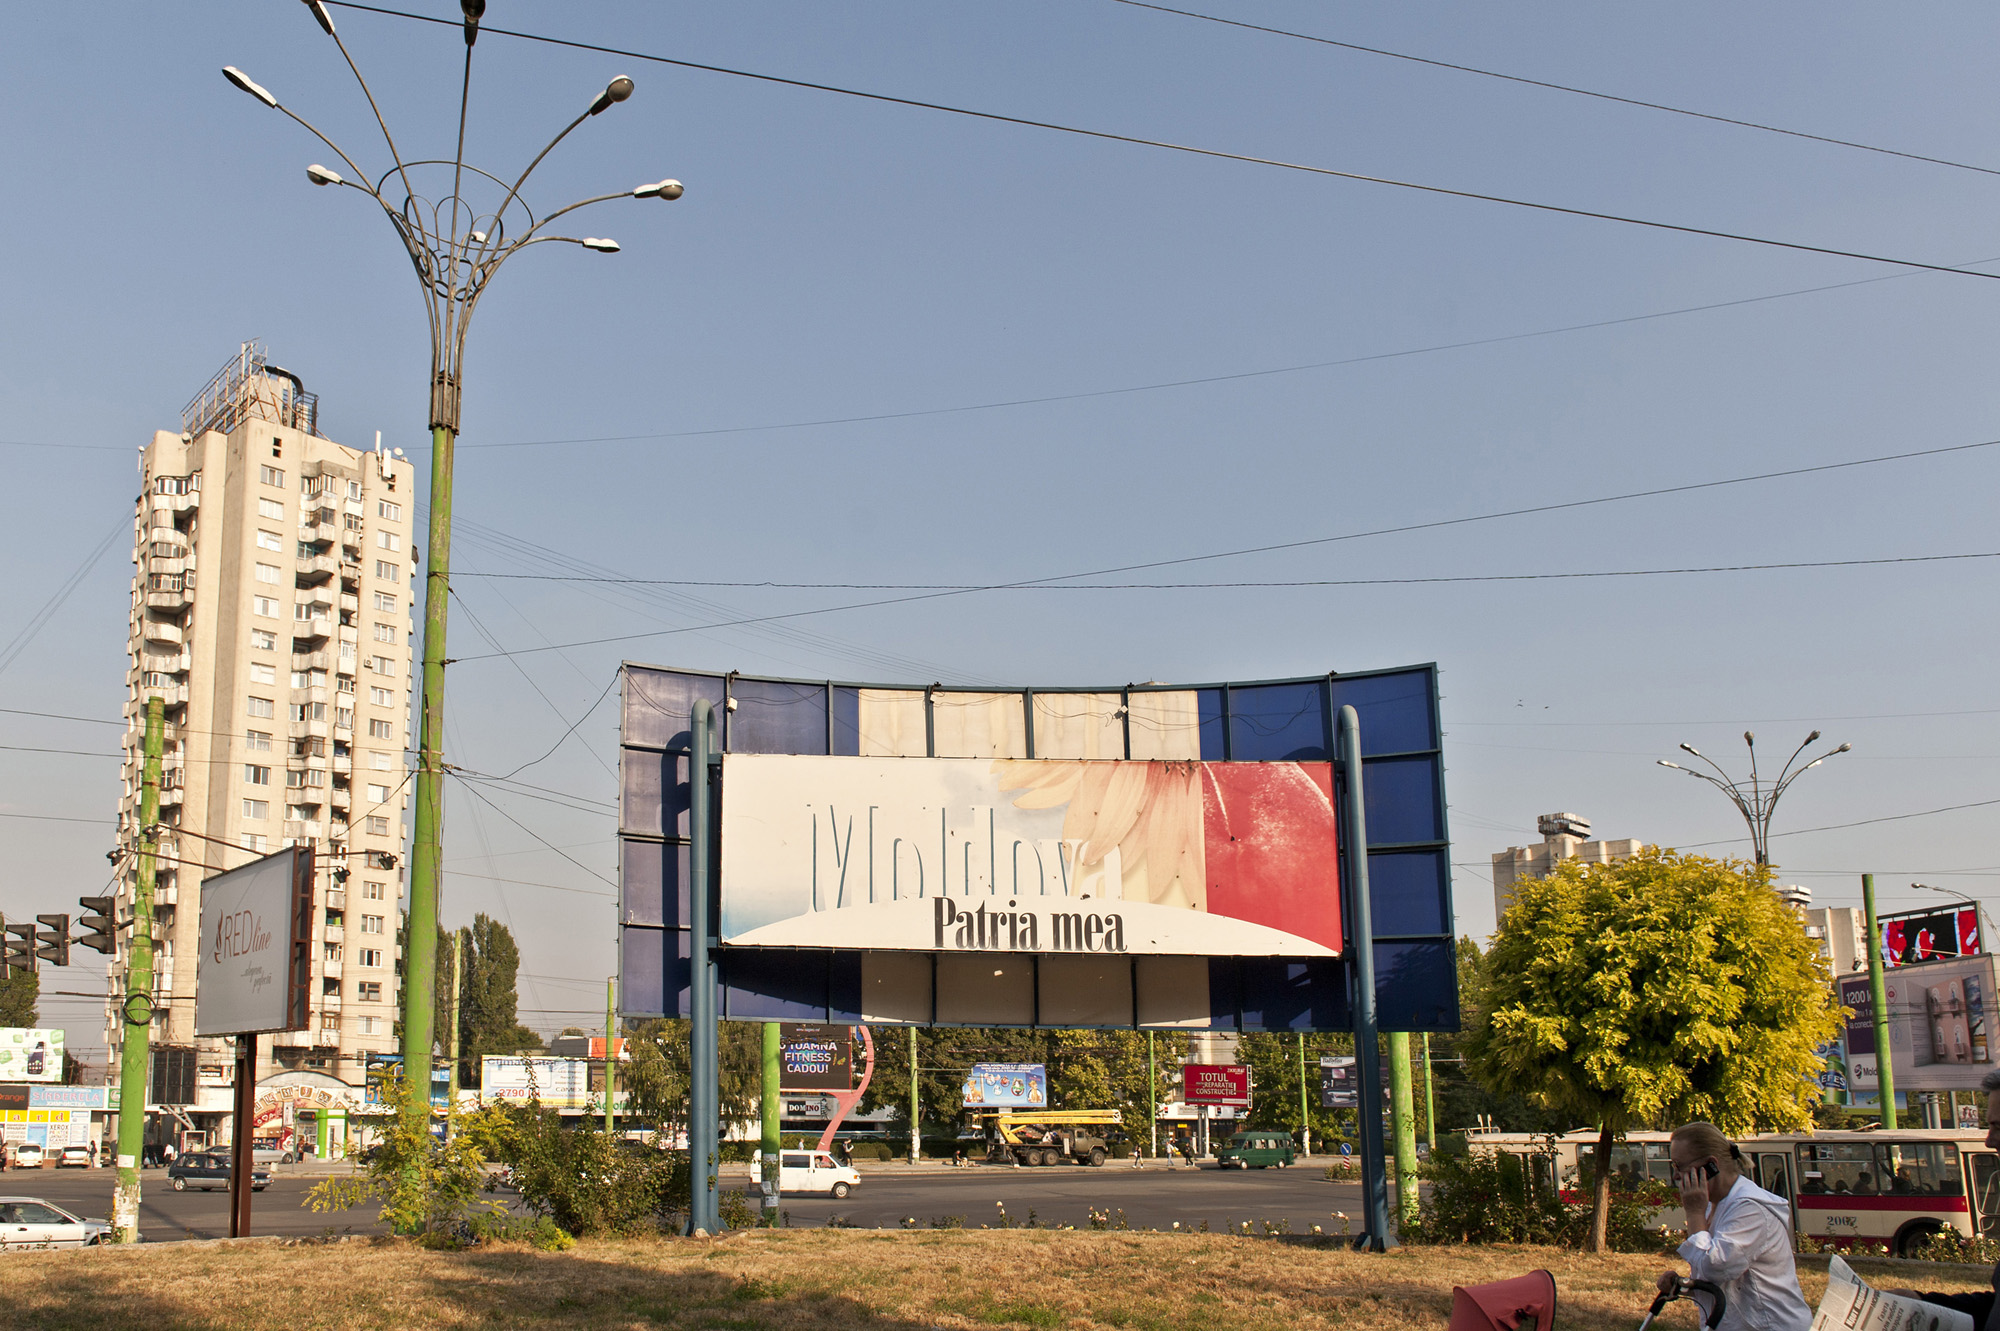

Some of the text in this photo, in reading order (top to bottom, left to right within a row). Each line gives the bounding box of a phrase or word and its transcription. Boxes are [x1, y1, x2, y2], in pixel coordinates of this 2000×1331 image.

[806, 803, 1122, 913] Moldova
[932, 896, 1128, 953] Patria mea
[1846, 990, 1866, 1005] 1200
[784, 1052, 832, 1062] FITNESS
[787, 1063, 829, 1073] CADOU!
[1199, 1072, 1229, 1082] TOTUL
[1821, 1074, 1846, 1087] EFES
[32, 1091, 100, 1102] SINDERELA
[499, 1088, 525, 1097] 2790
[788, 1104, 820, 1112] DOMINO
[1877, 1302, 1889, 1322] Газета
[1887, 1300, 1898, 1322] любого
